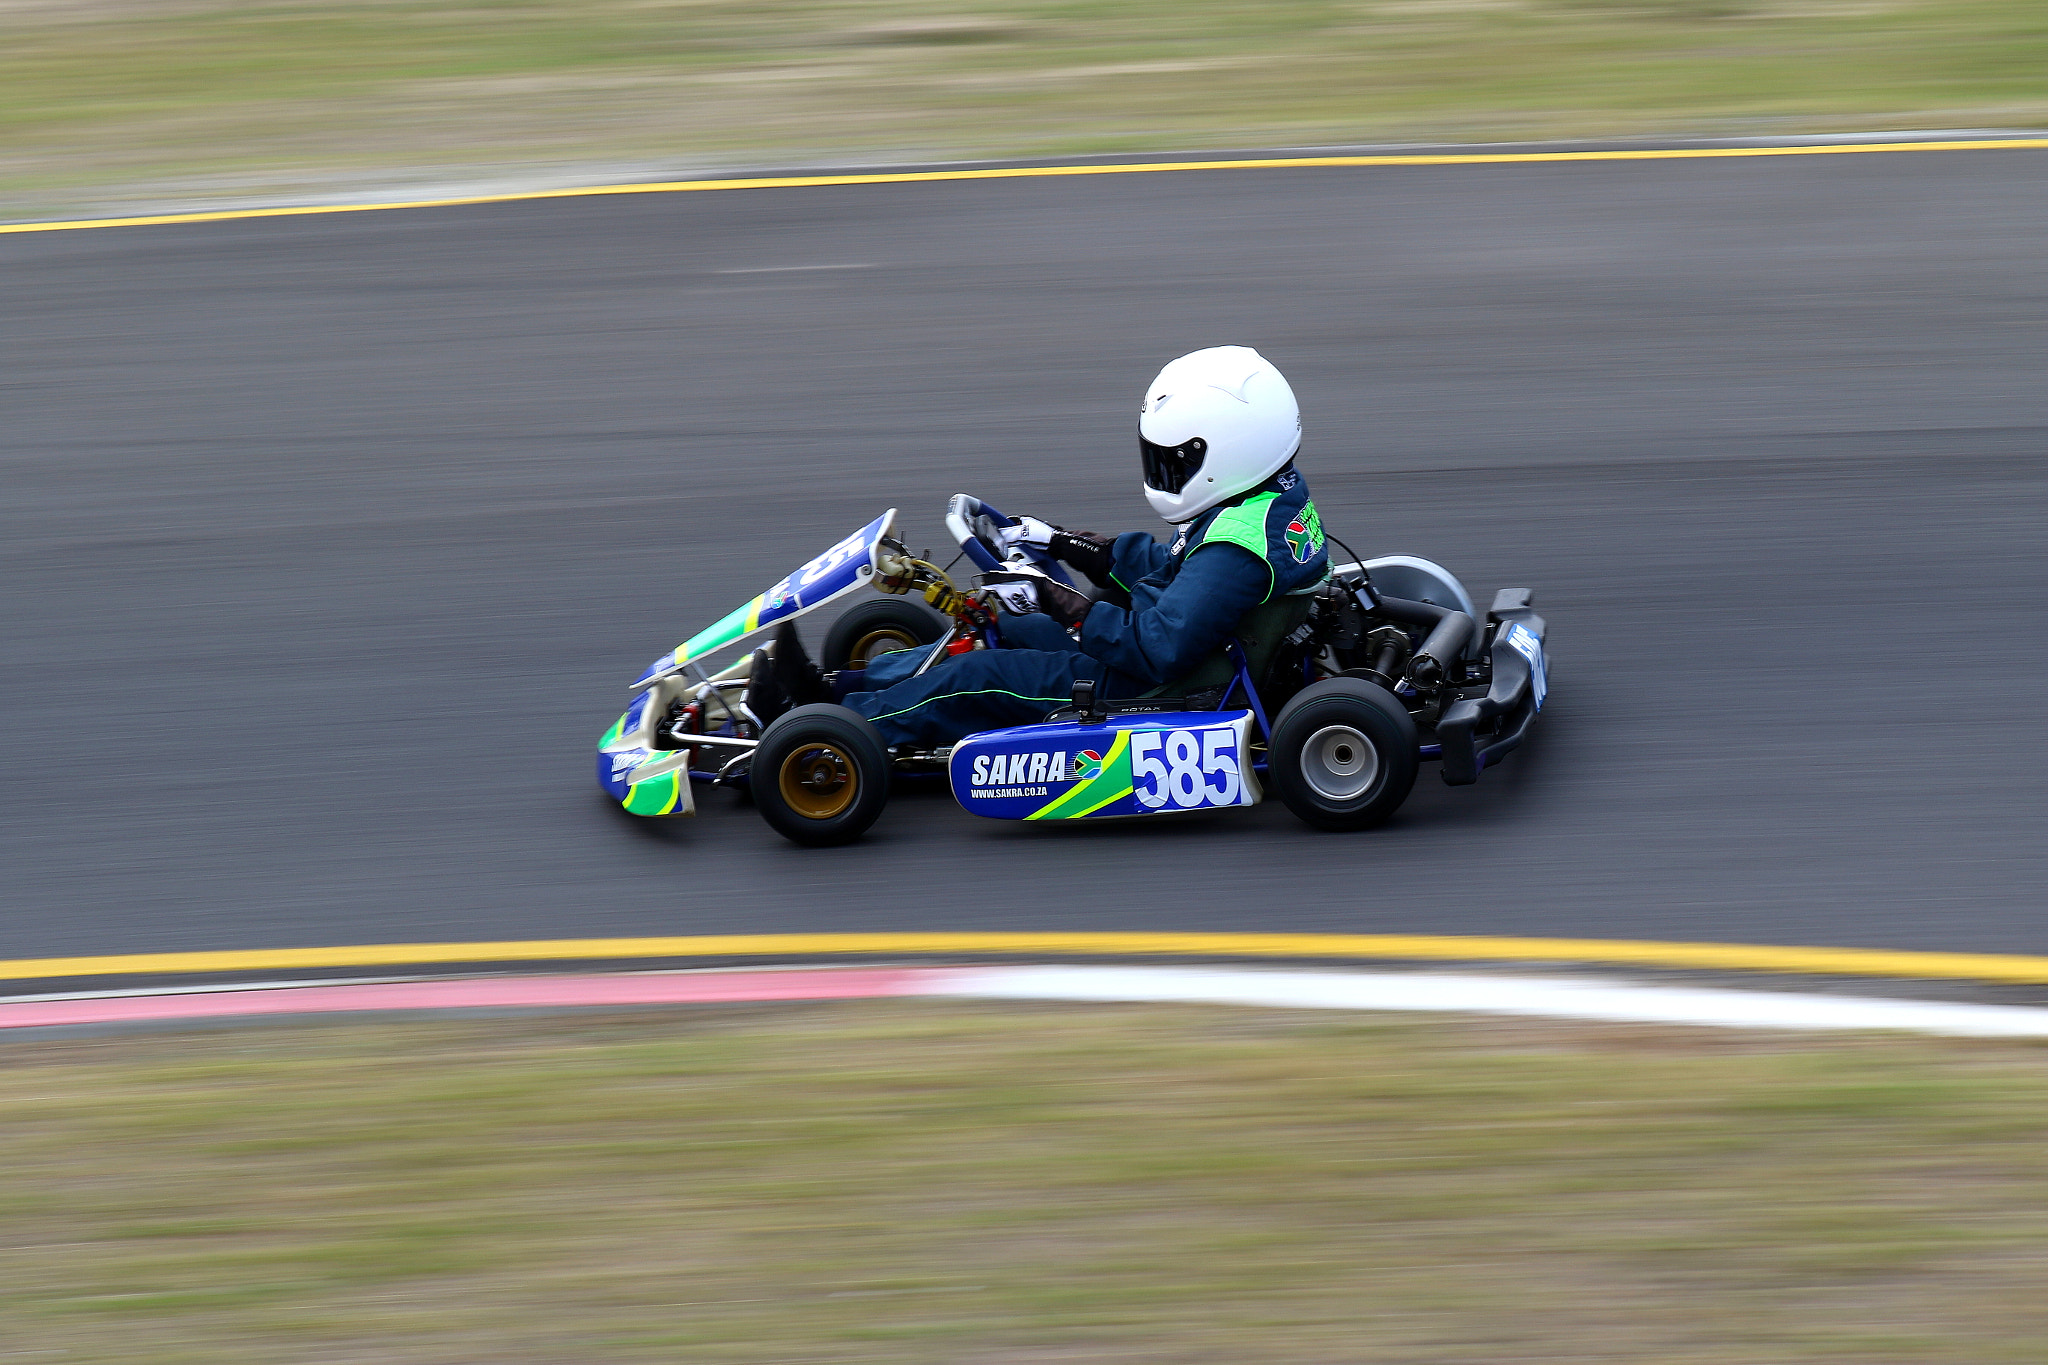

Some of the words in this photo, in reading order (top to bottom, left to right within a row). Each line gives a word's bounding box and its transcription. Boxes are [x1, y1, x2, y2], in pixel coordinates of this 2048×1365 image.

[971, 751, 1066, 786] SAKRA
[1130, 729, 1240, 808] 585
[971, 786, 1048, 799] WWW.SAKRA.CO.ZA
